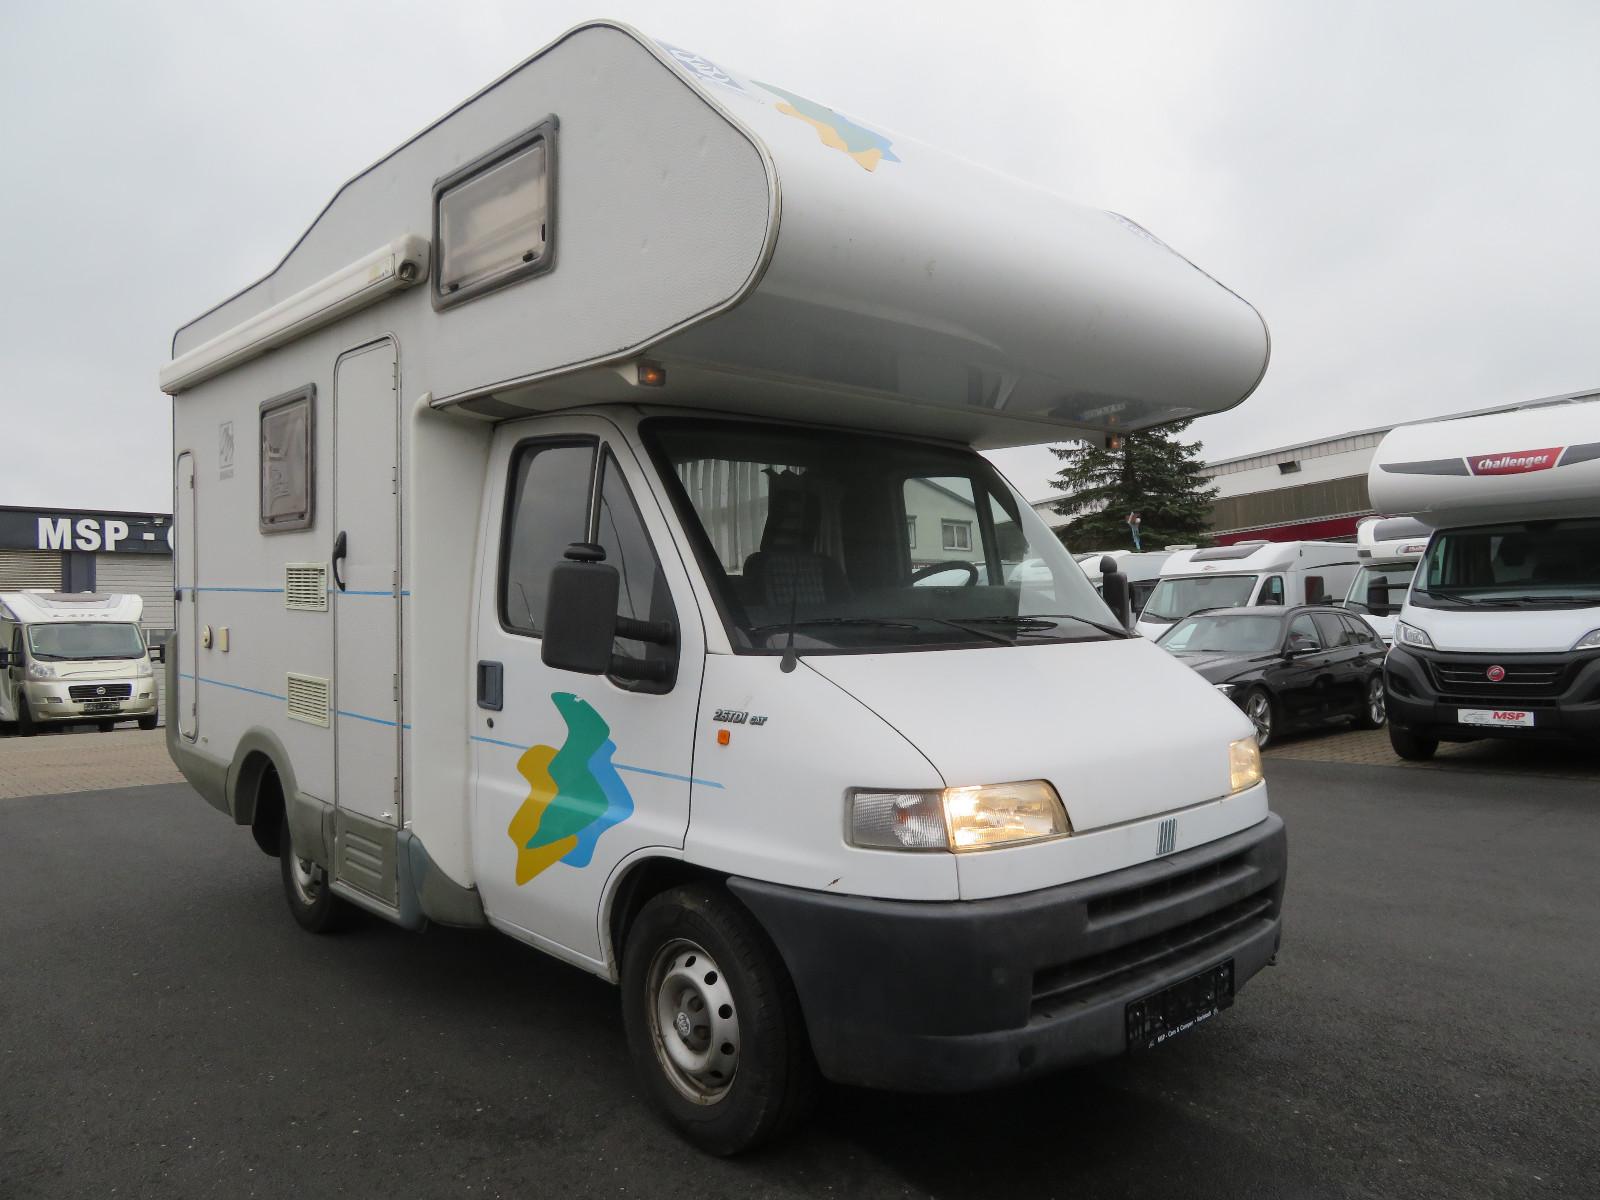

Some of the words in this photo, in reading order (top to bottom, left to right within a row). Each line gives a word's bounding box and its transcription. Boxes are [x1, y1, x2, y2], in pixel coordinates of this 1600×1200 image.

[1477, 454, 1549, 469] Challenger
[38, 517, 129, 551] MSP
[1493, 711, 1525, 720] MSP
